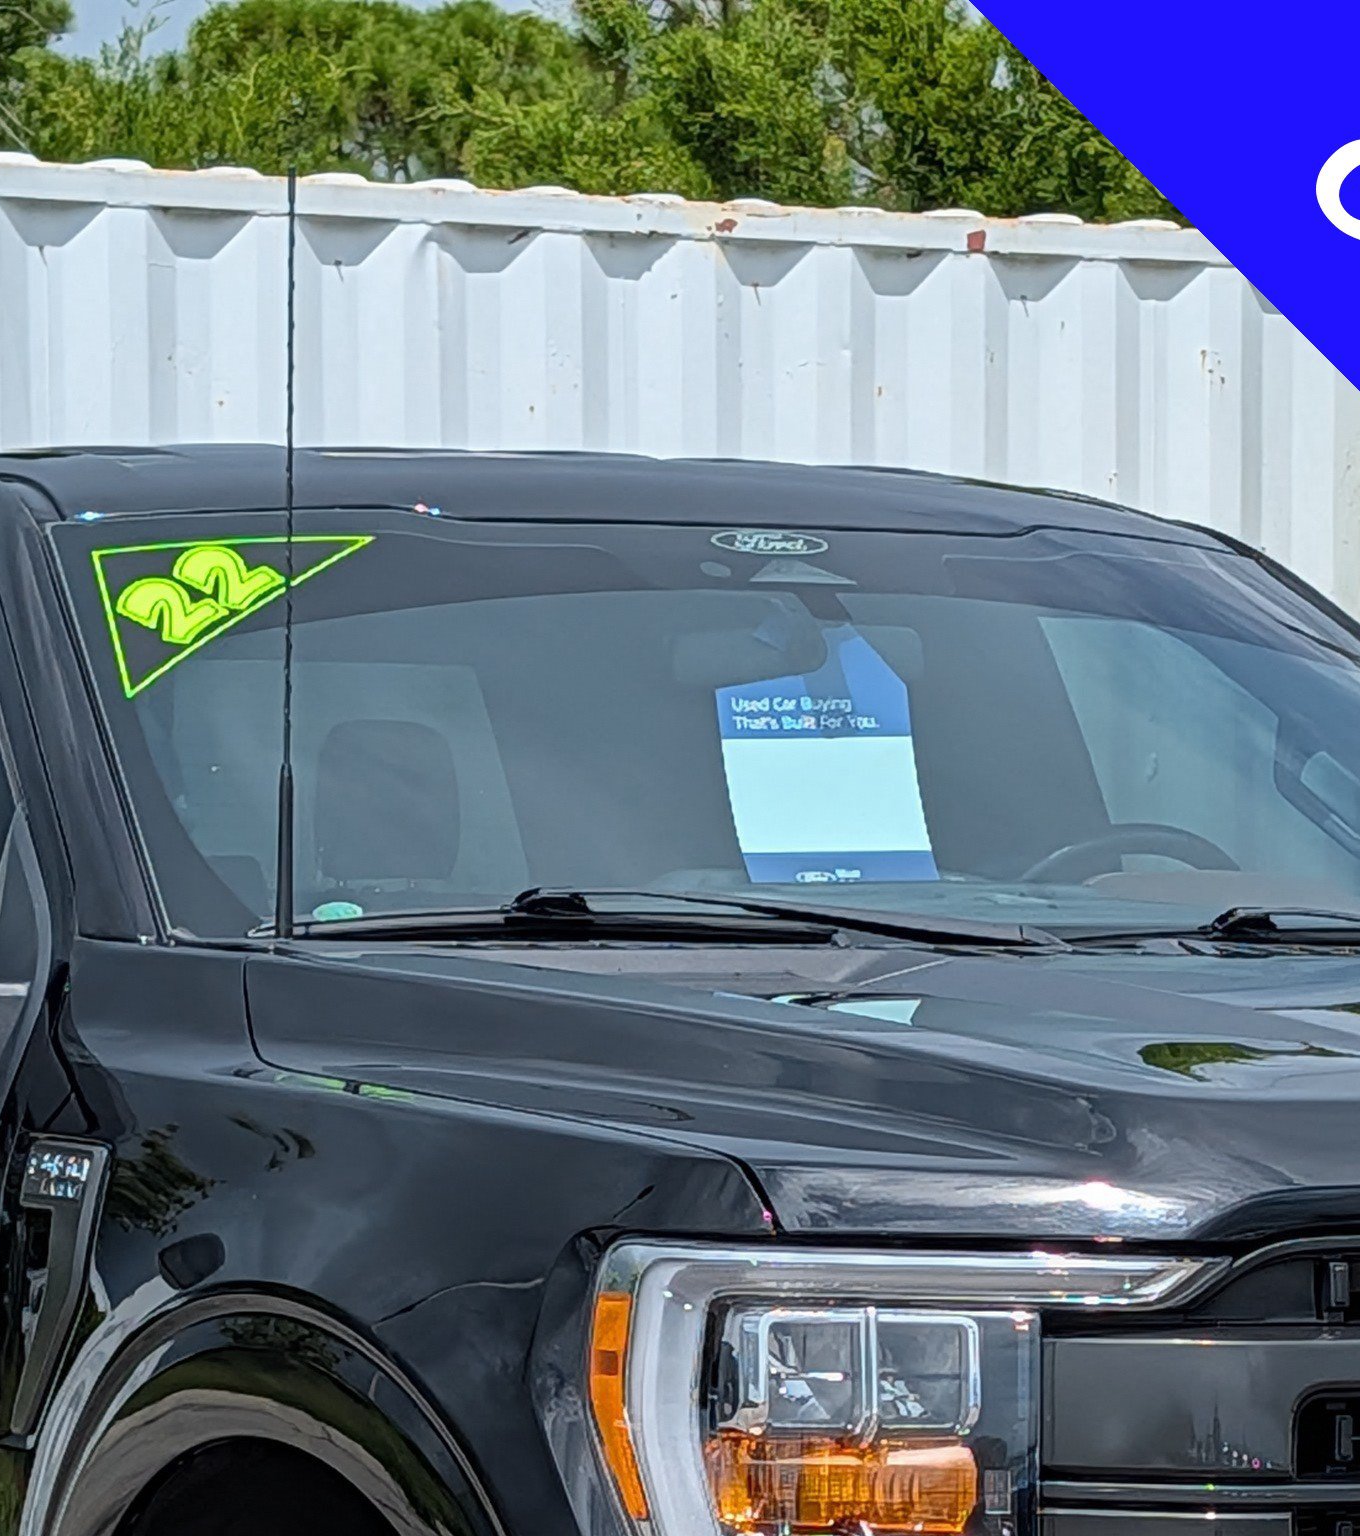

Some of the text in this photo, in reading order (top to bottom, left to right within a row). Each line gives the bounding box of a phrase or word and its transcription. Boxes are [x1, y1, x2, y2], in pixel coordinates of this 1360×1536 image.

[116, 545, 287, 645] 22
[731, 697, 770, 712] Used
[772, 697, 797, 712] Car
